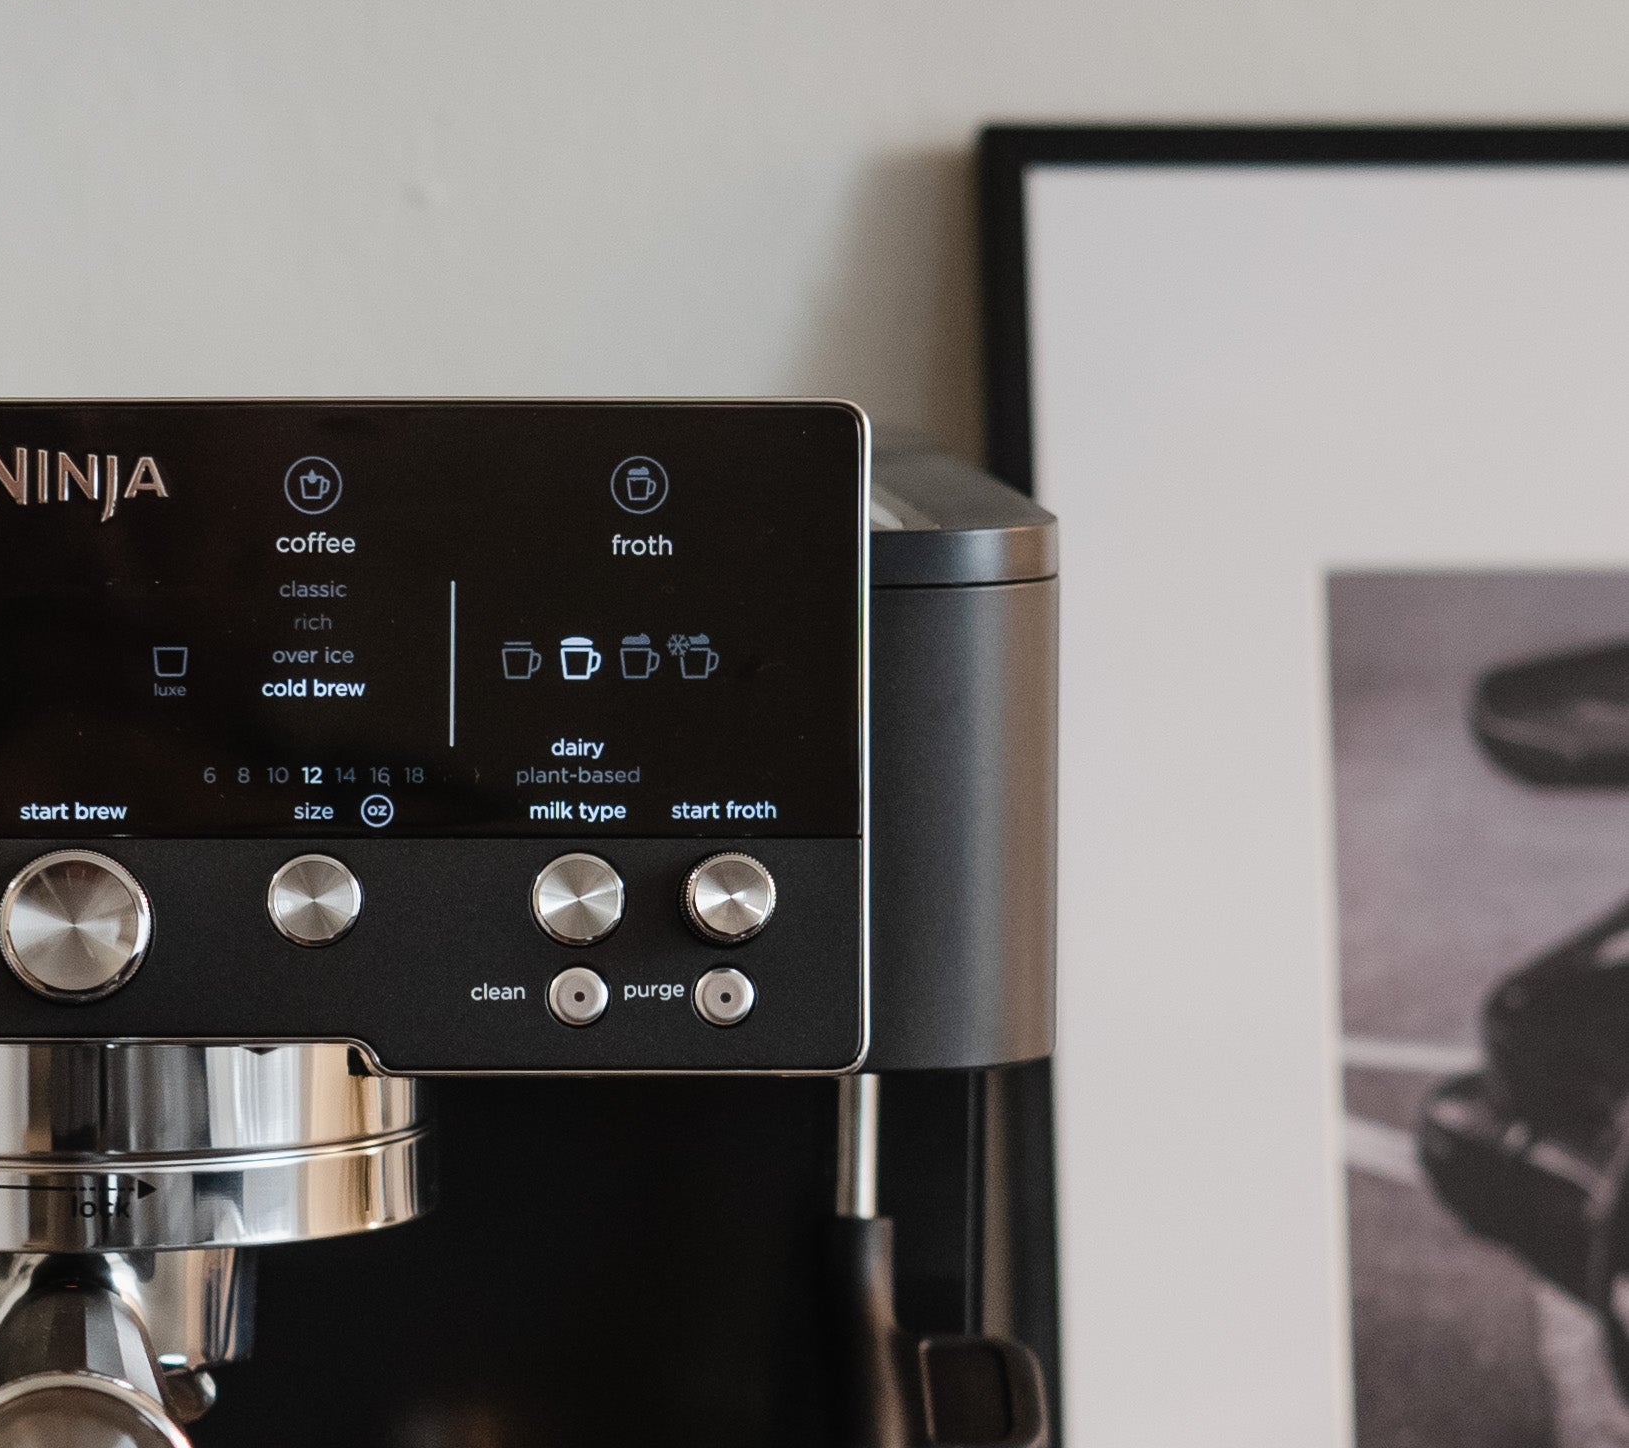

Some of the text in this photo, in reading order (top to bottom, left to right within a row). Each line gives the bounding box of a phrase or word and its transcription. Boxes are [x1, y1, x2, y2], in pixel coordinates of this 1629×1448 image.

[275, 530, 356, 554] coffee
[611, 532, 673, 556] froth
[279, 579, 347, 598] classic
[294, 612, 332, 631] rich
[272, 645, 355, 664] over ice
[153, 681, 187, 697] luxe
[261, 677, 366, 698] cold brew
[551, 736, 605, 760] dairy
[203, 765, 425, 785] 6 8 10 12 14 16 18
[516, 765, 640, 786] plant-based
[19, 800, 128, 821] start brew
[294, 800, 334, 820] size
[367, 804, 388, 816] oz
[529, 799, 627, 823] milk type
[671, 799, 777, 820] start froth
[470, 981, 526, 1001] clean
[623, 982, 685, 1001] purge
[72, 1194, 130, 1218] lock
